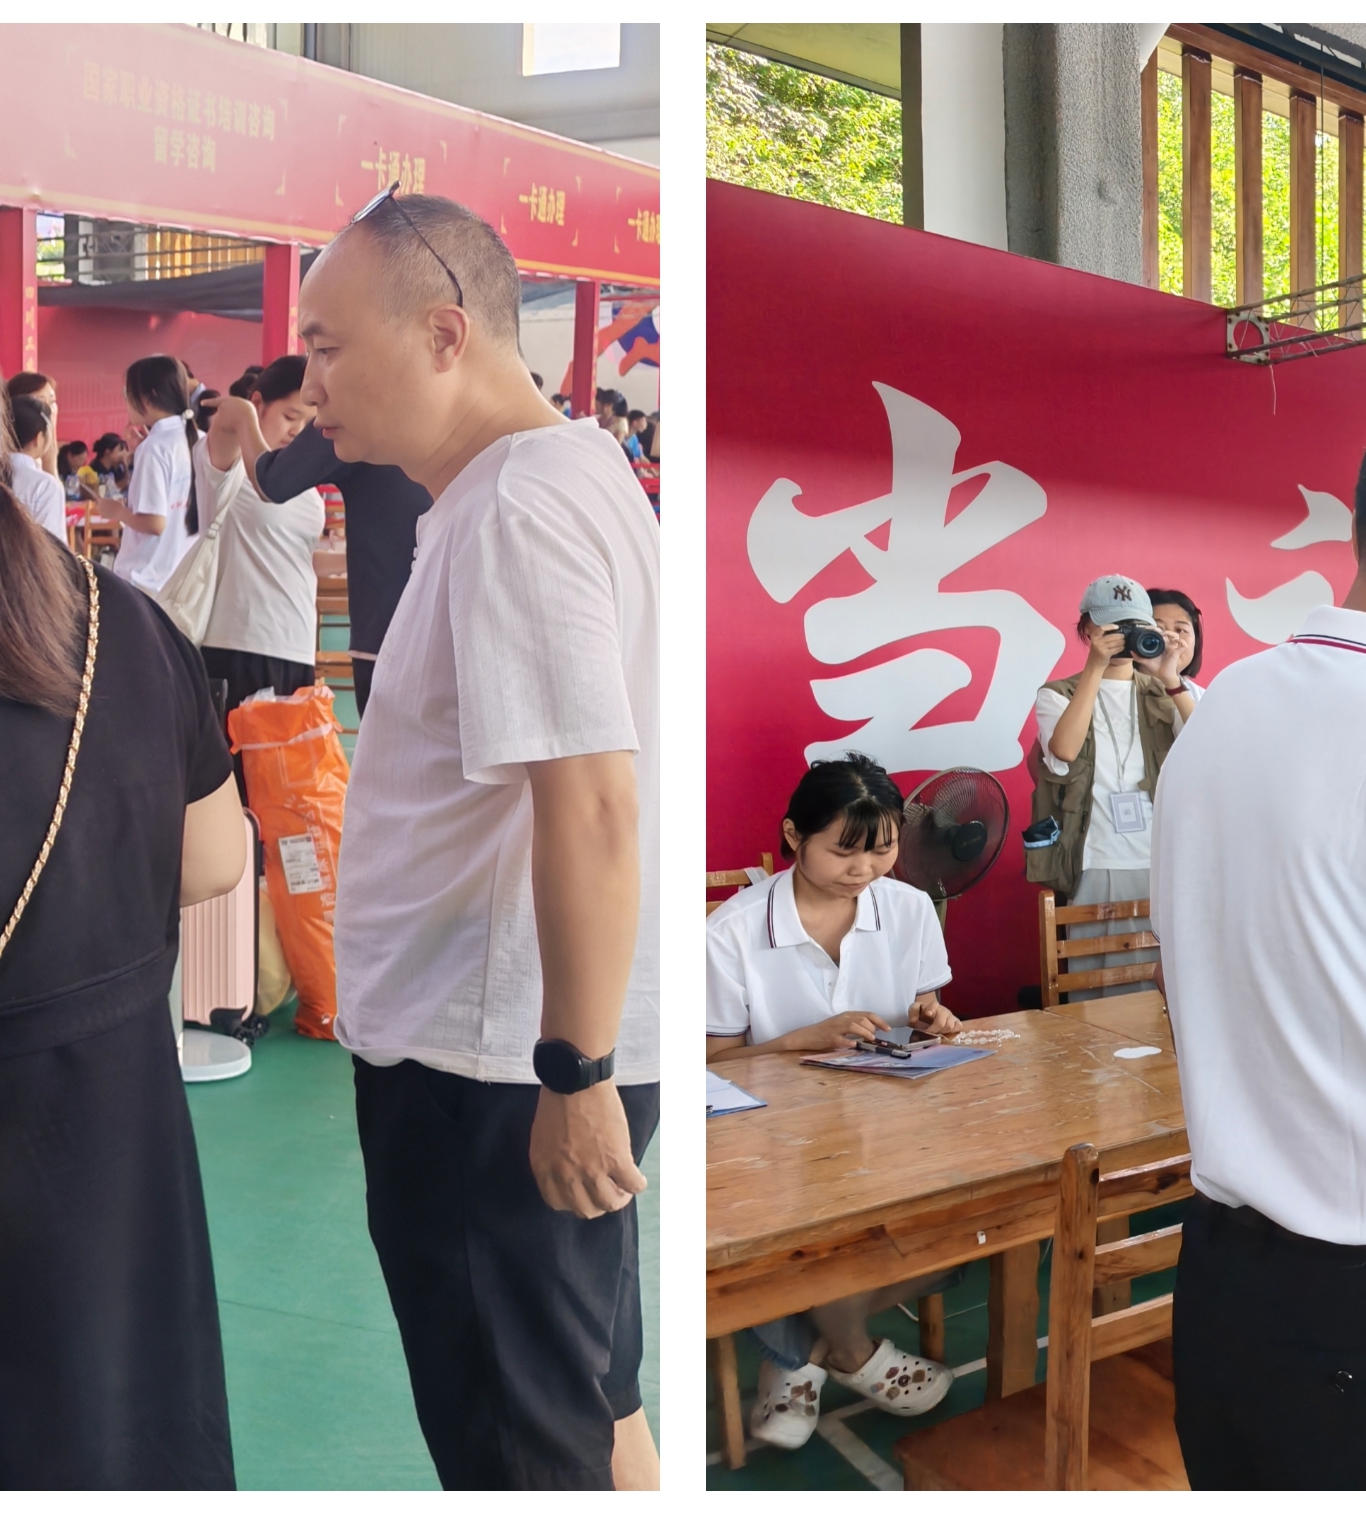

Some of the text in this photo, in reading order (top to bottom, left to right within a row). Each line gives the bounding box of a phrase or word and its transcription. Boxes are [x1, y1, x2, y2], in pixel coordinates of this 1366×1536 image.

[154, 124, 217, 173] 留学咨询
[519, 182, 566, 227] 一卡通办理
